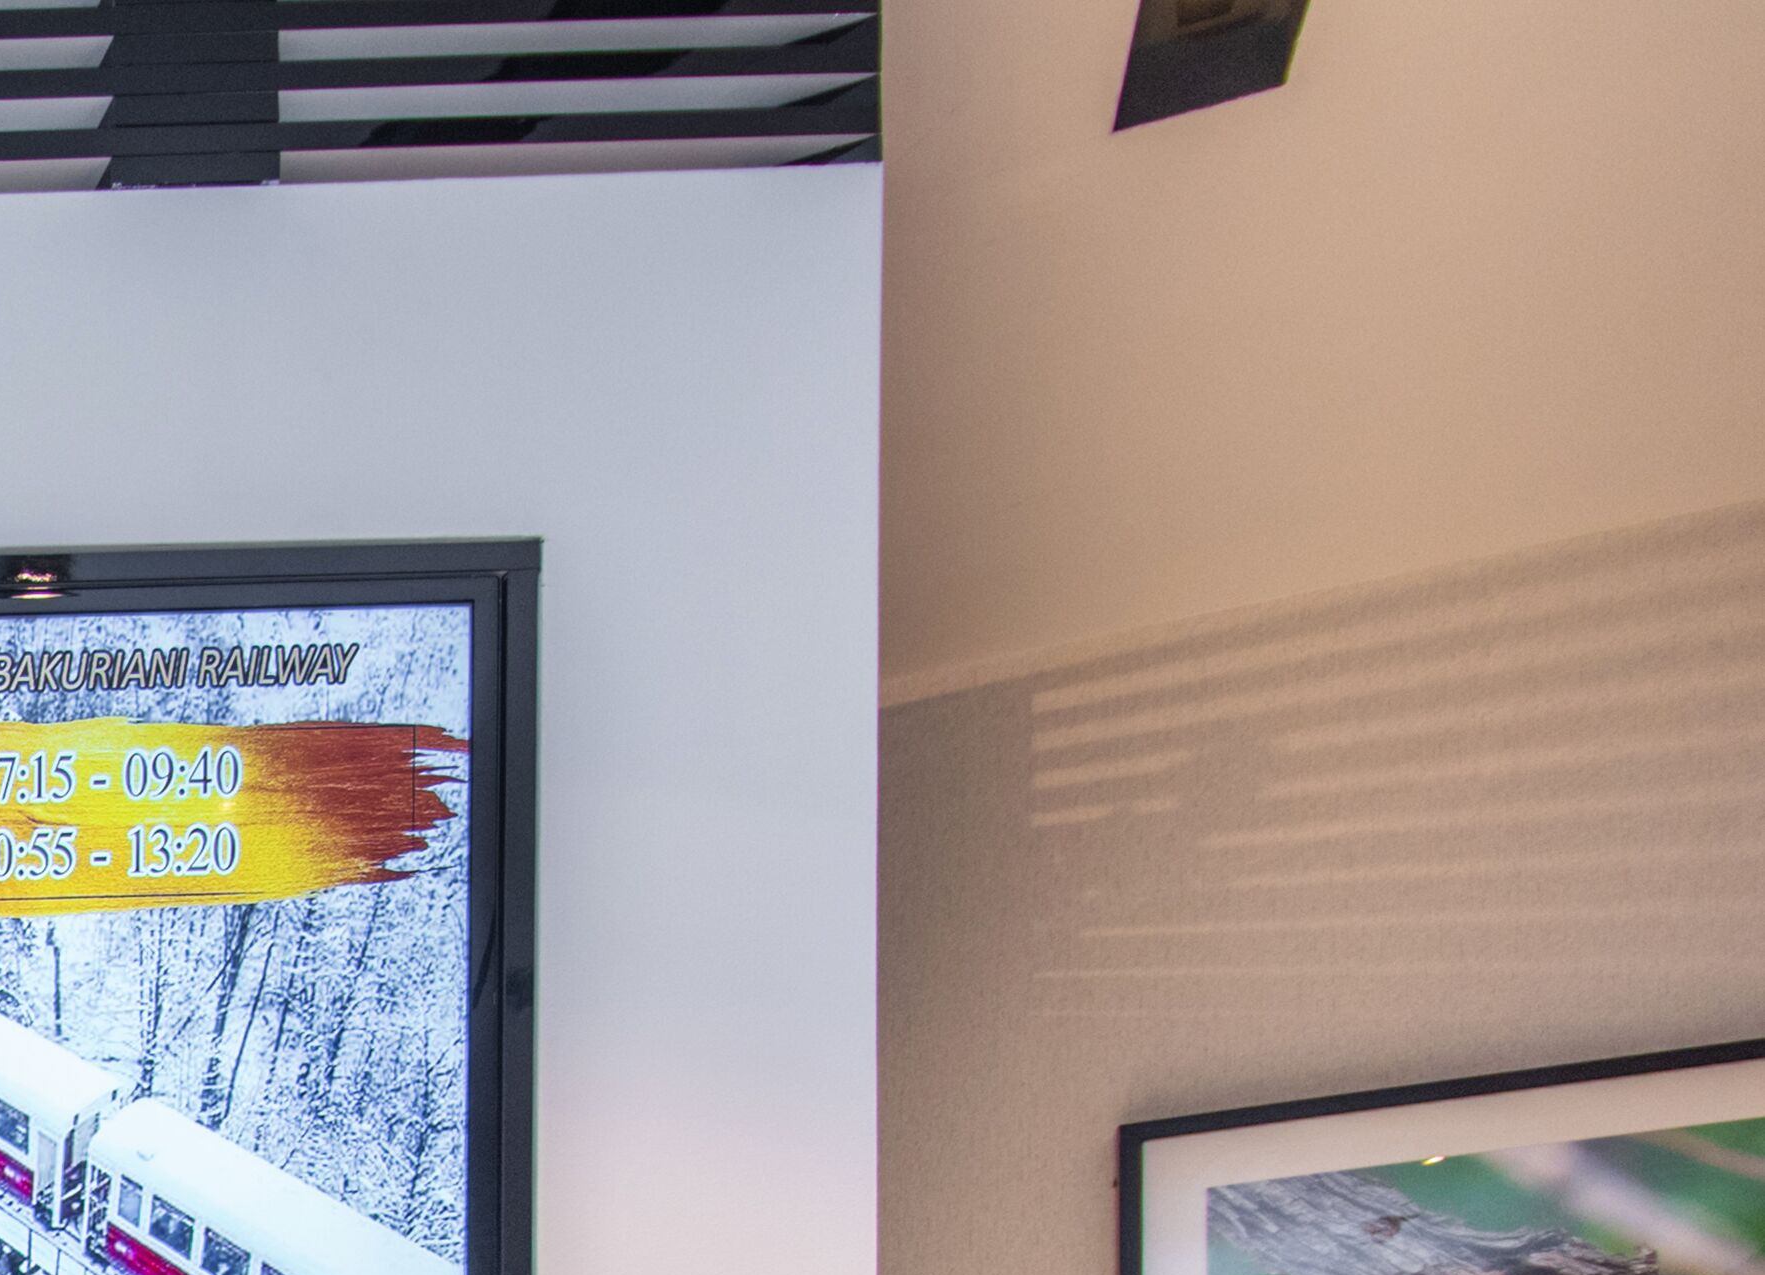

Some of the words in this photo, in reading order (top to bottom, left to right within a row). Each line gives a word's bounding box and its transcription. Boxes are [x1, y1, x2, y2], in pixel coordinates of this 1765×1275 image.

[196, 643, 359, 688] RAILWAY
[123, 745, 242, 799] 09:40
[128, 822, 239, 876] 13:20
